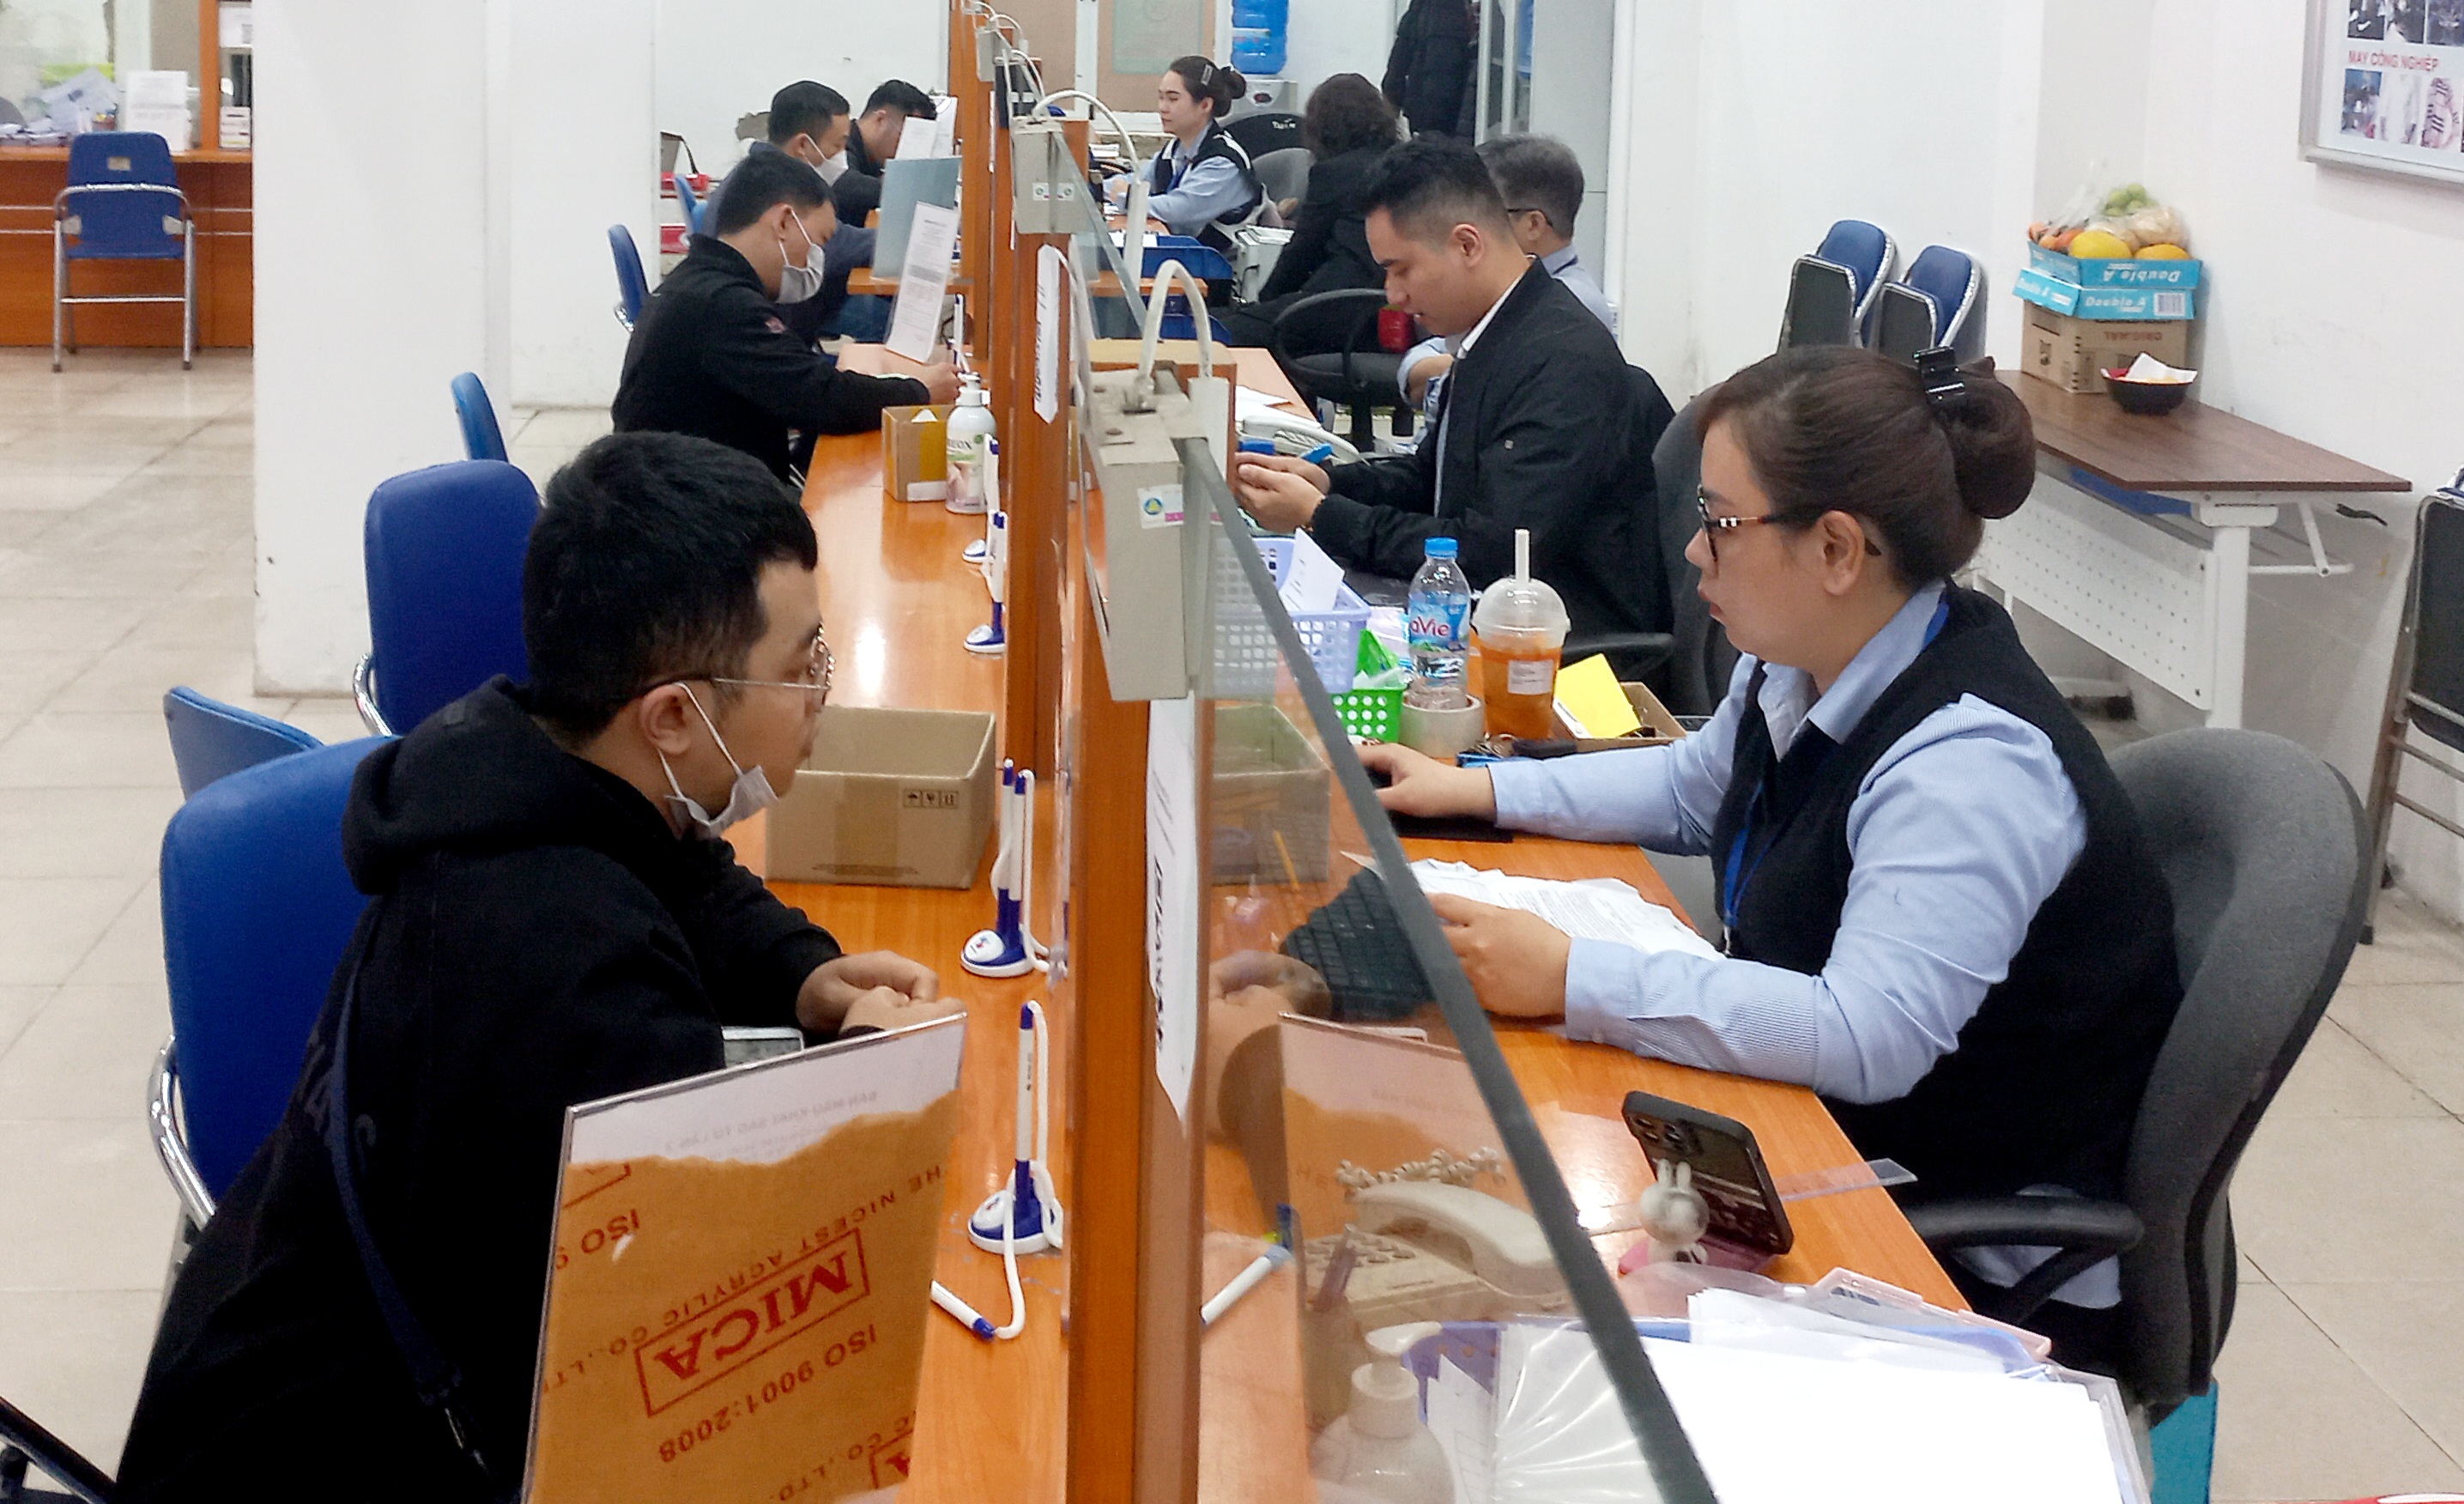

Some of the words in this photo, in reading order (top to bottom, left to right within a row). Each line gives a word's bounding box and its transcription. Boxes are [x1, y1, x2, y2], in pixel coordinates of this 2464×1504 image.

[2120, 270, 2182, 282] Double
[1410, 616, 1450, 636] aVie
[908, 1165, 941, 1193] HE
[580, 1209, 639, 1254] ISO
[797, 1192, 896, 1252] NICEST
[663, 1250, 782, 1327] ACRYLIC
[653, 1250, 853, 1382] MICA
[825, 1324, 876, 1368] ISO
[658, 1360, 814, 1464] 9001:2008
